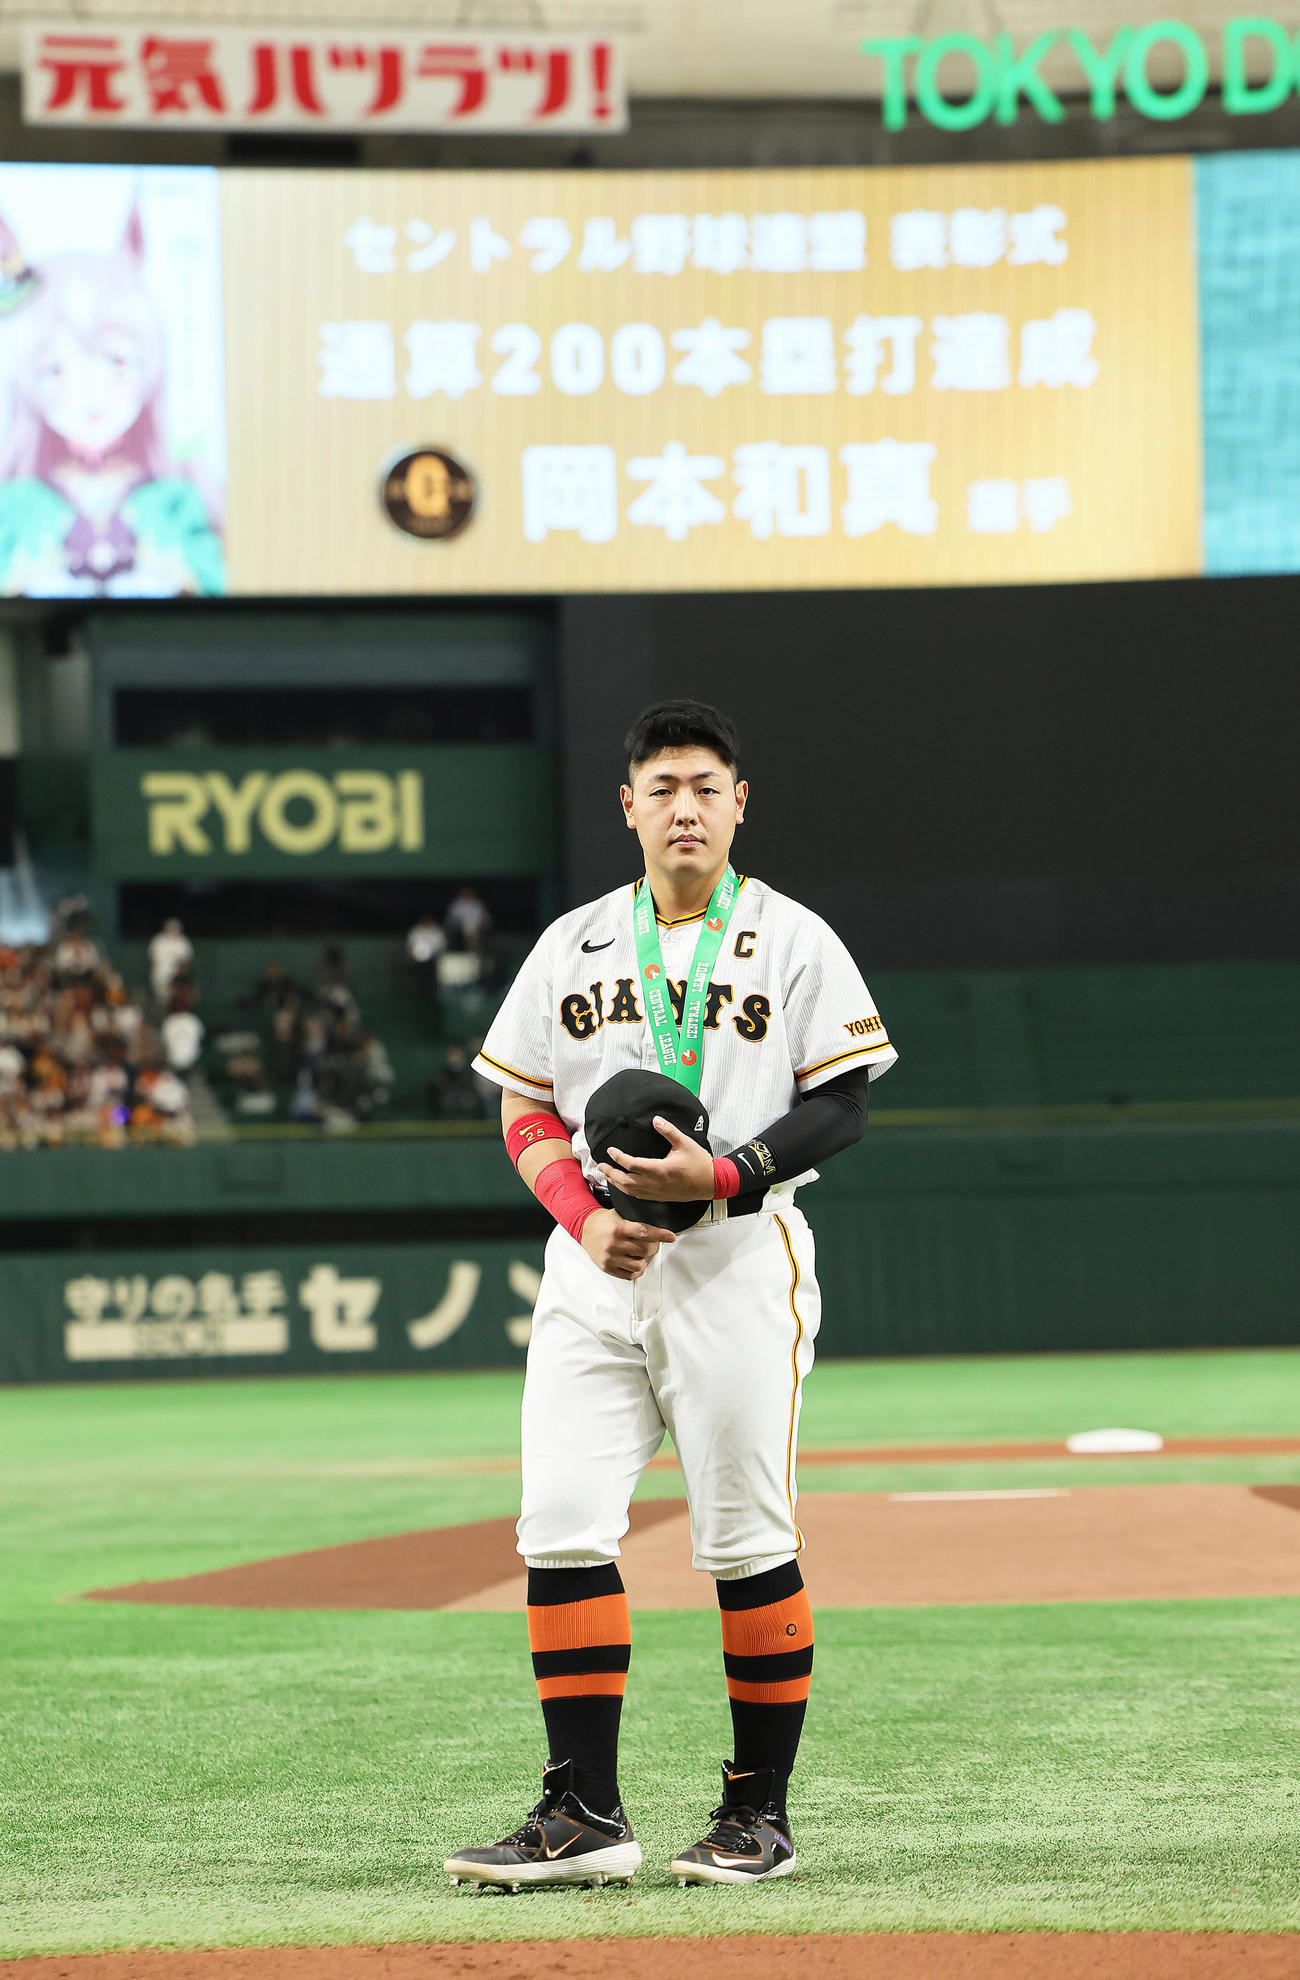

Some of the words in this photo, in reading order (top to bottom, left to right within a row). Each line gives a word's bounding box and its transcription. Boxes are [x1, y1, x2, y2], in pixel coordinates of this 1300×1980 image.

[858, 18, 1209, 132] TOKYO
[1222, 16, 1300, 116] D
[141, 769, 424, 855] RYOBI
[733, 931, 757, 959] C
[692, 961, 710, 993] LEAGUE
[560, 978, 772, 1043] GIANTS
[649, 988, 668, 1027] CENTRAL
[686, 1000, 701, 1039] CENTRAL
[842, 1015, 883, 1038] YOMI
[658, 1032, 677, 1066] LEAGUE
[525, 1127, 545, 1142] 25
